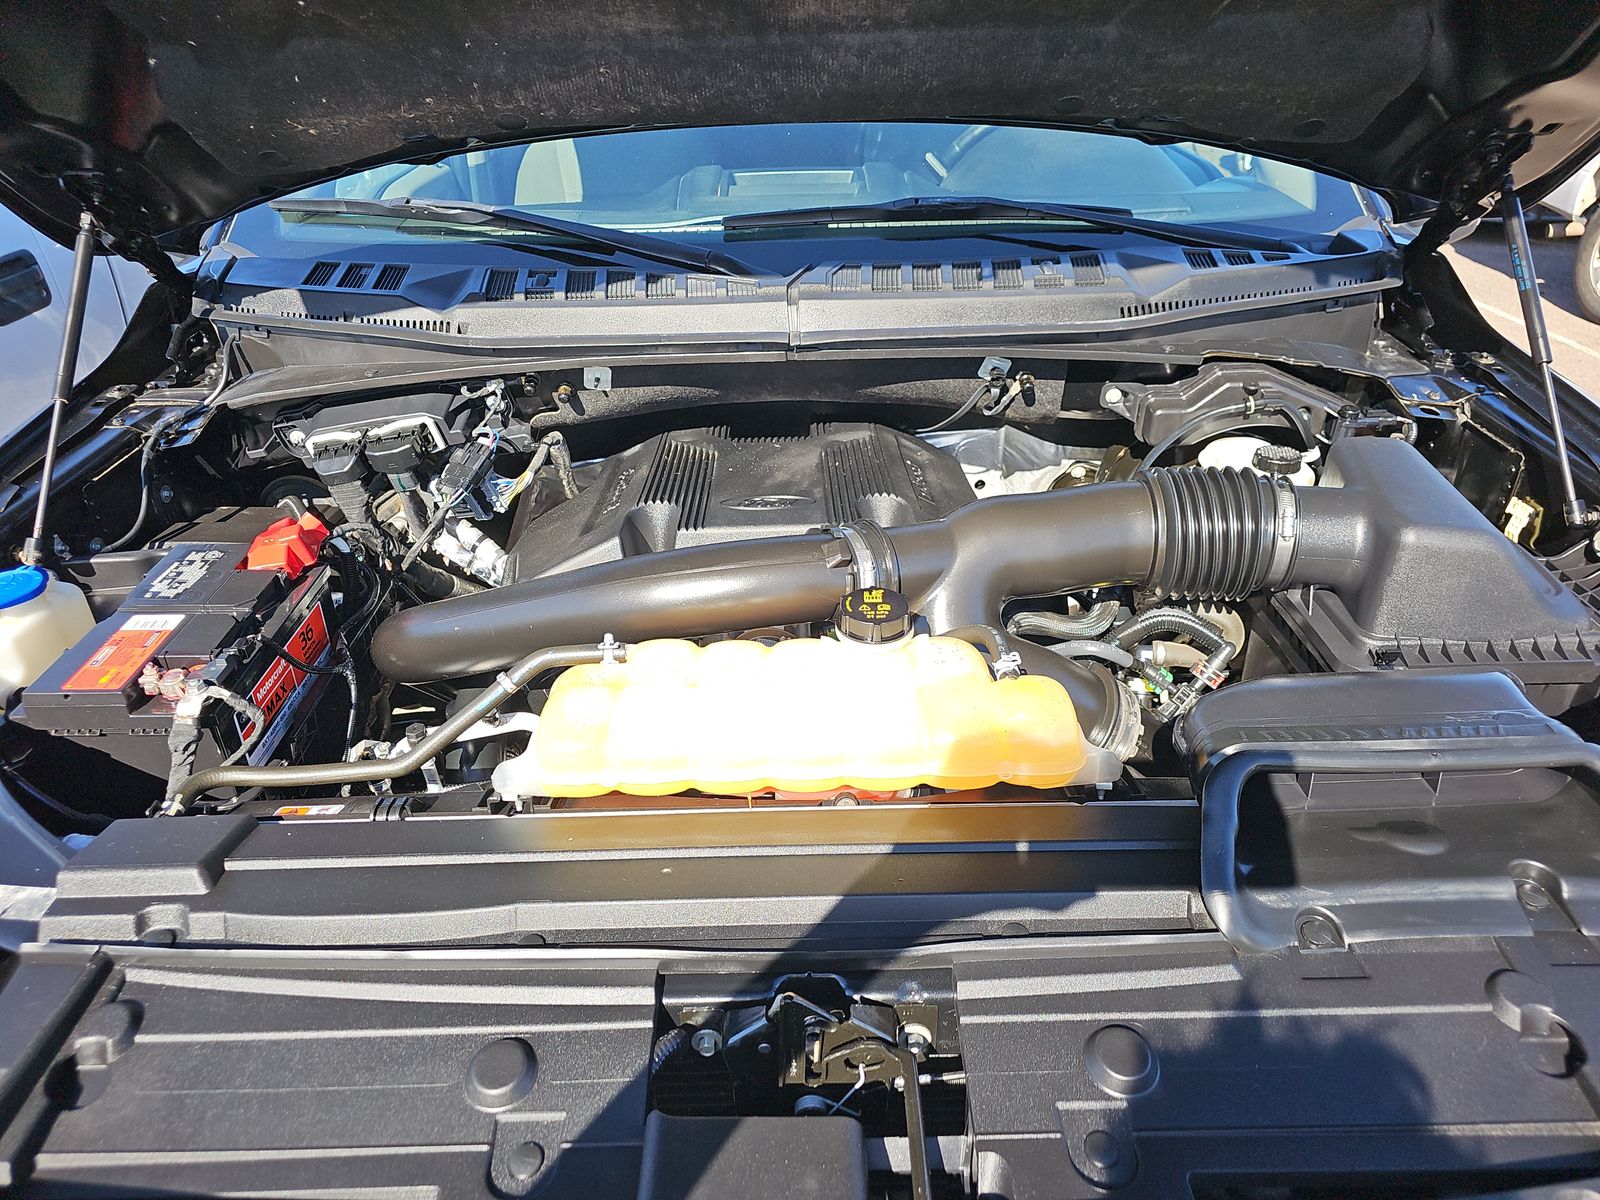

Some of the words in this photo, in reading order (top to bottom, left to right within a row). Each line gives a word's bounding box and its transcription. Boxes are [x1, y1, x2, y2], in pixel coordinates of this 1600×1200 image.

[299, 623, 314, 651] 36
[256, 658, 287, 702] Motorcraft
[265, 681, 289, 717] MAX
